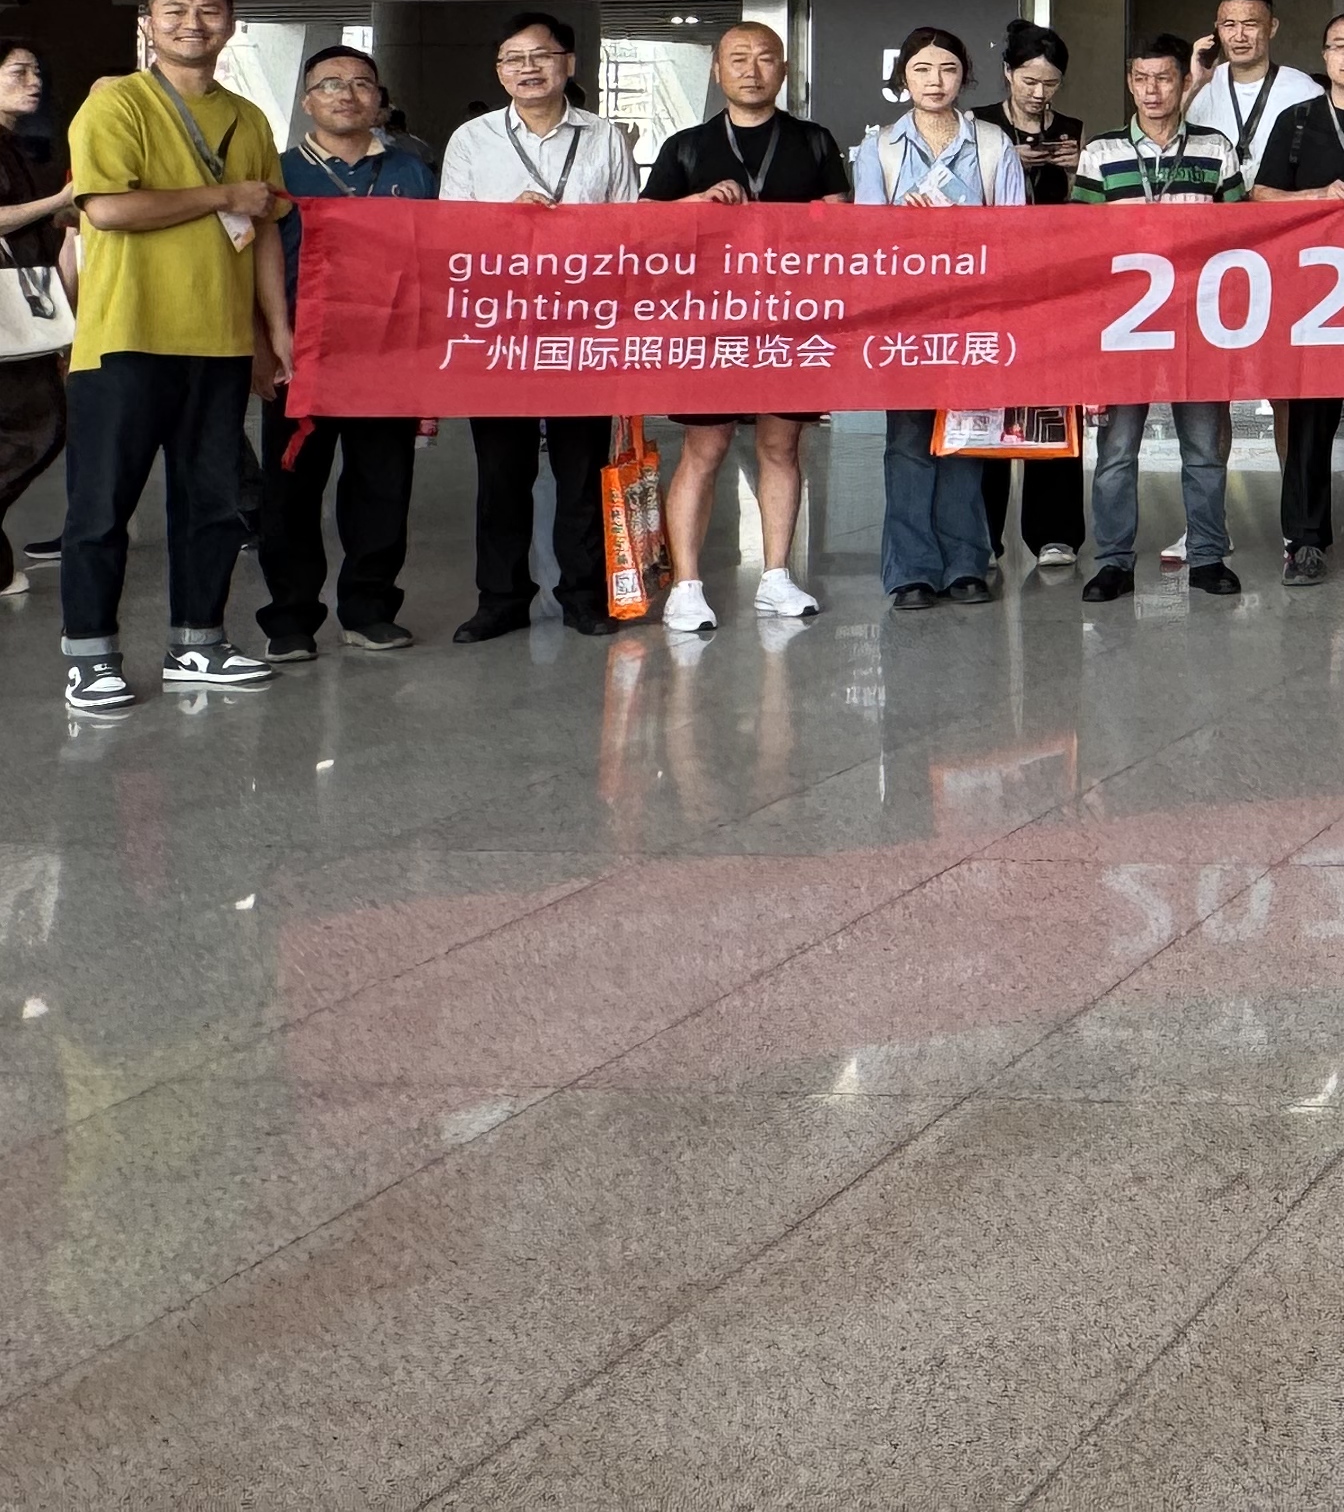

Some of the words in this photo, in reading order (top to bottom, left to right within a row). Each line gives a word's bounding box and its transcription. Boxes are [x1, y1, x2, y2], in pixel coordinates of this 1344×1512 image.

[447, 244, 698, 284] guangzhou
[722, 244, 989, 276] international
[445, 288, 619, 329] lighting
[632, 290, 846, 322] exhibition
